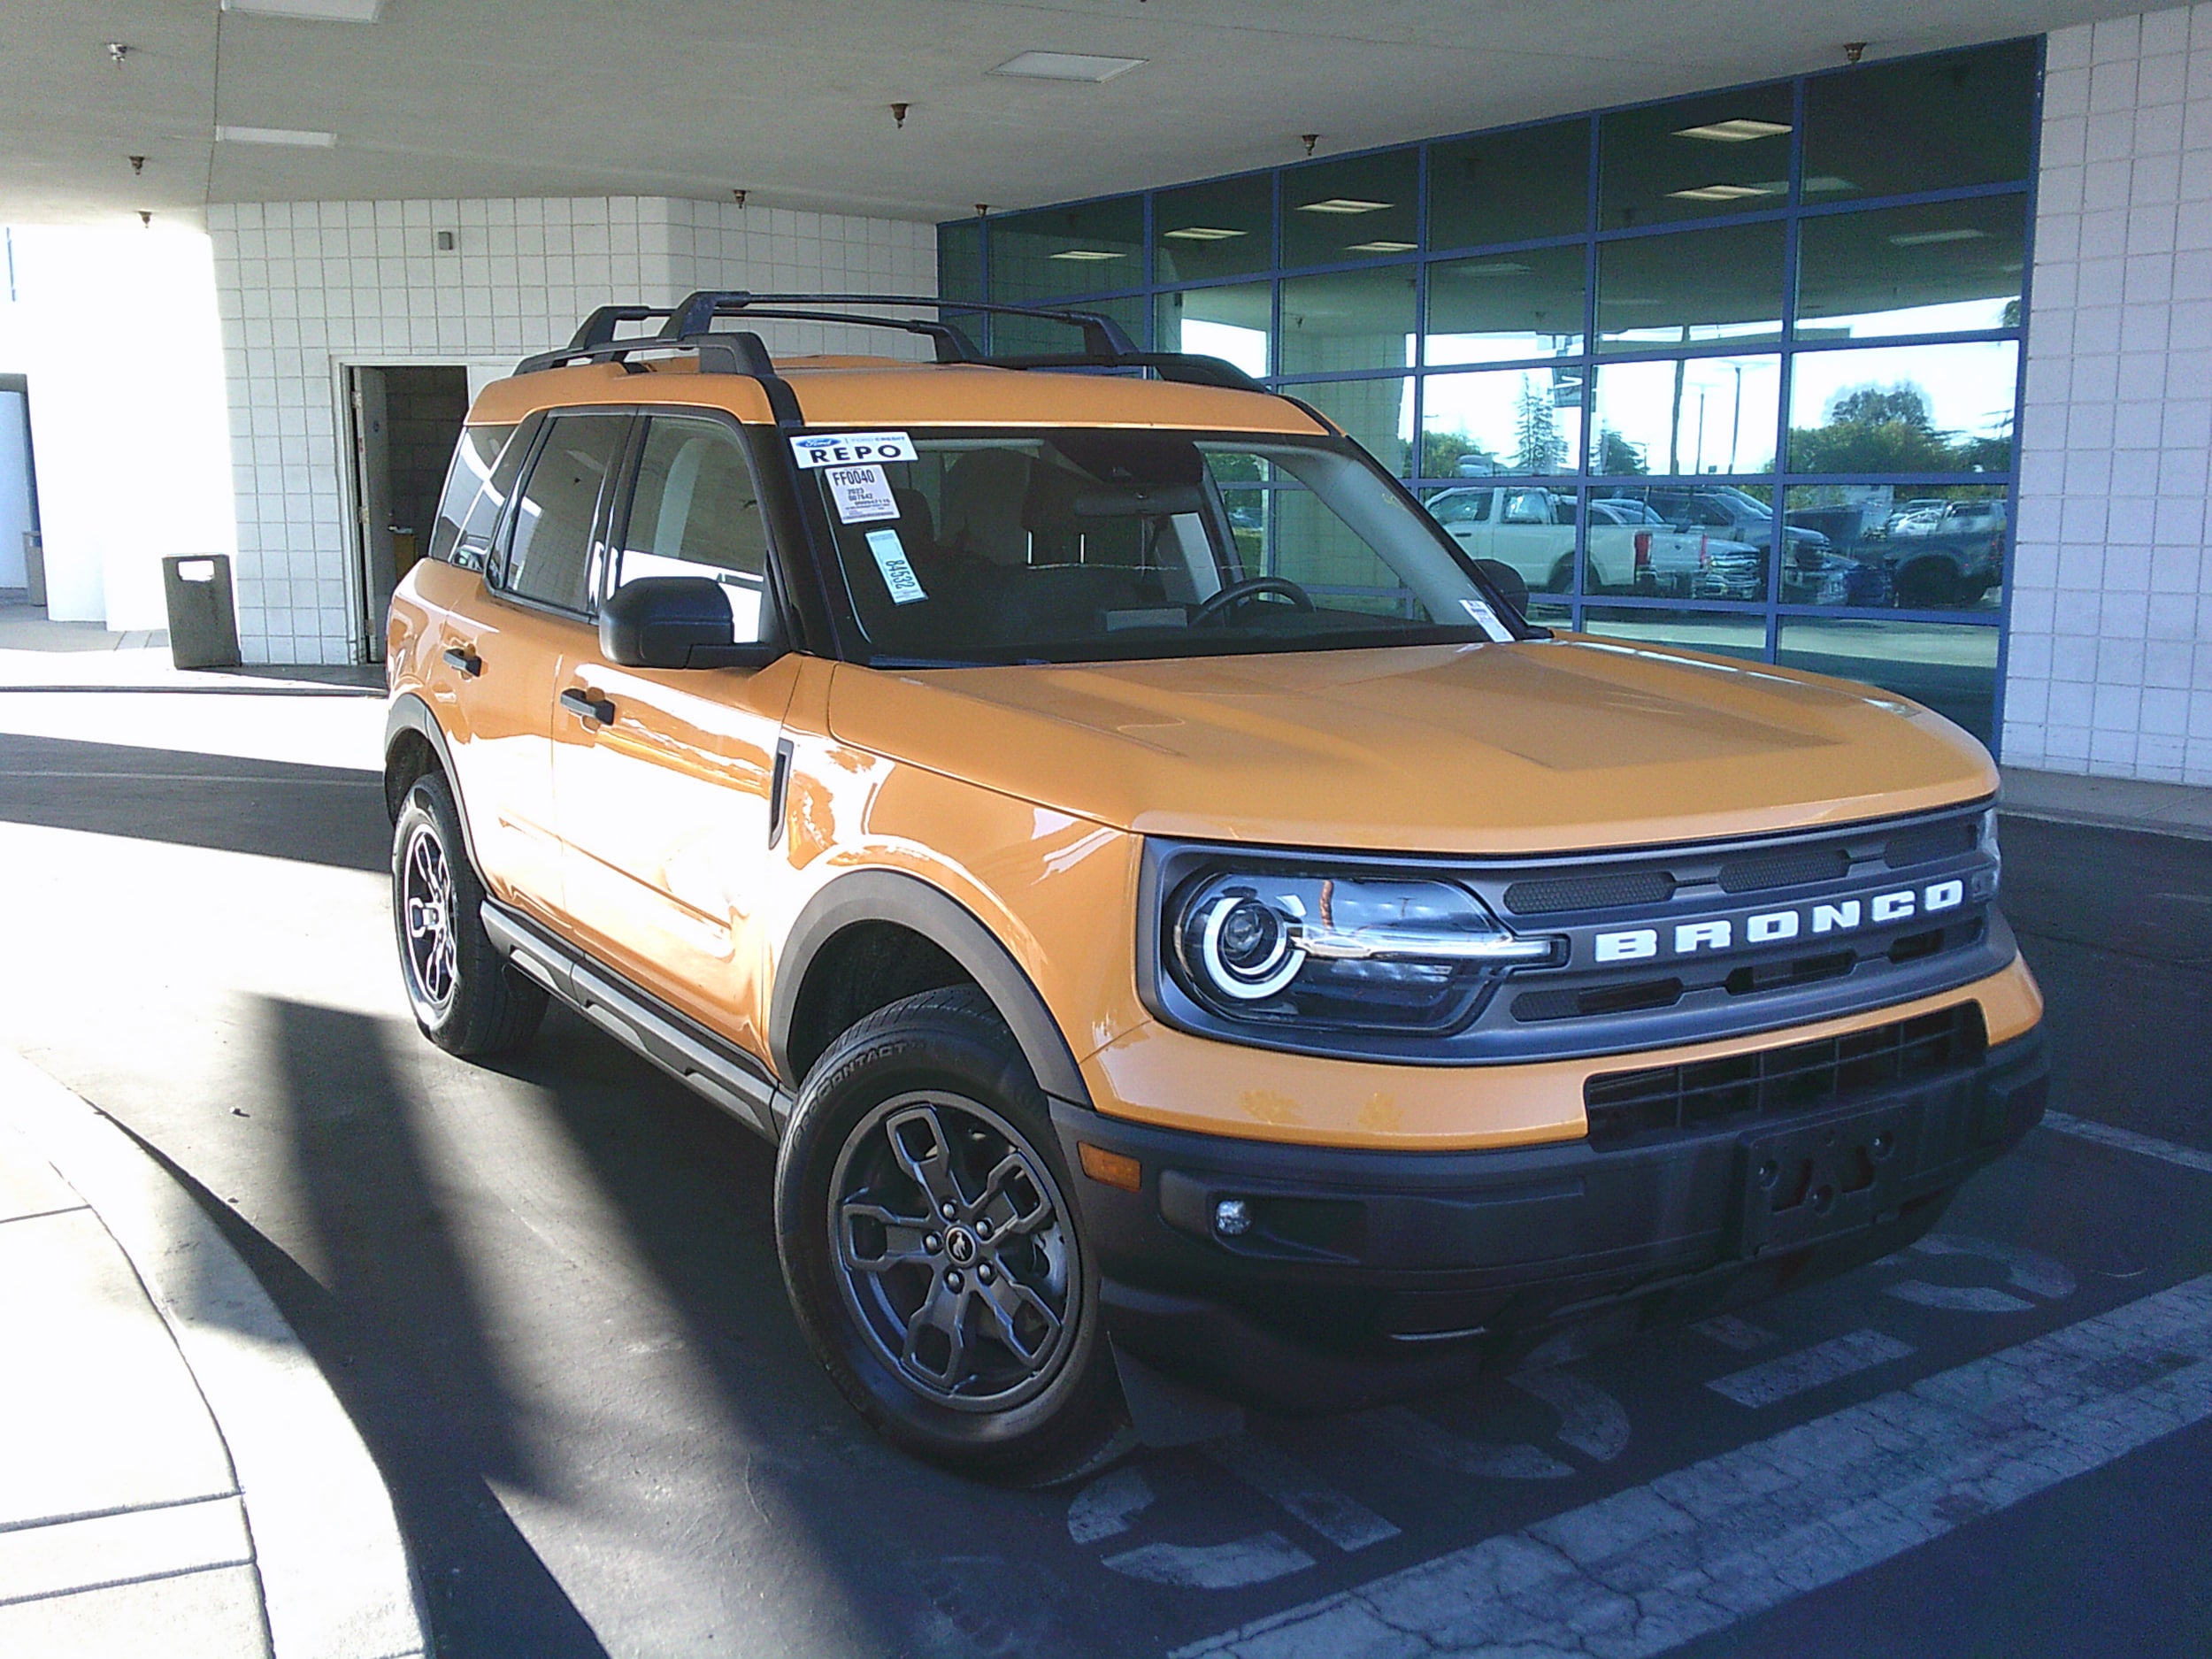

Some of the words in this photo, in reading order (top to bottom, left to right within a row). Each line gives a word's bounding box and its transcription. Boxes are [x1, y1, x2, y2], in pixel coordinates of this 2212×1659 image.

[805, 438, 833, 448] Ford
[810, 444, 902, 464] REPO
[832, 469, 875, 487] FF0040
[886, 559, 916, 589] 84532
[1594, 879, 1964, 964] BRONCO
